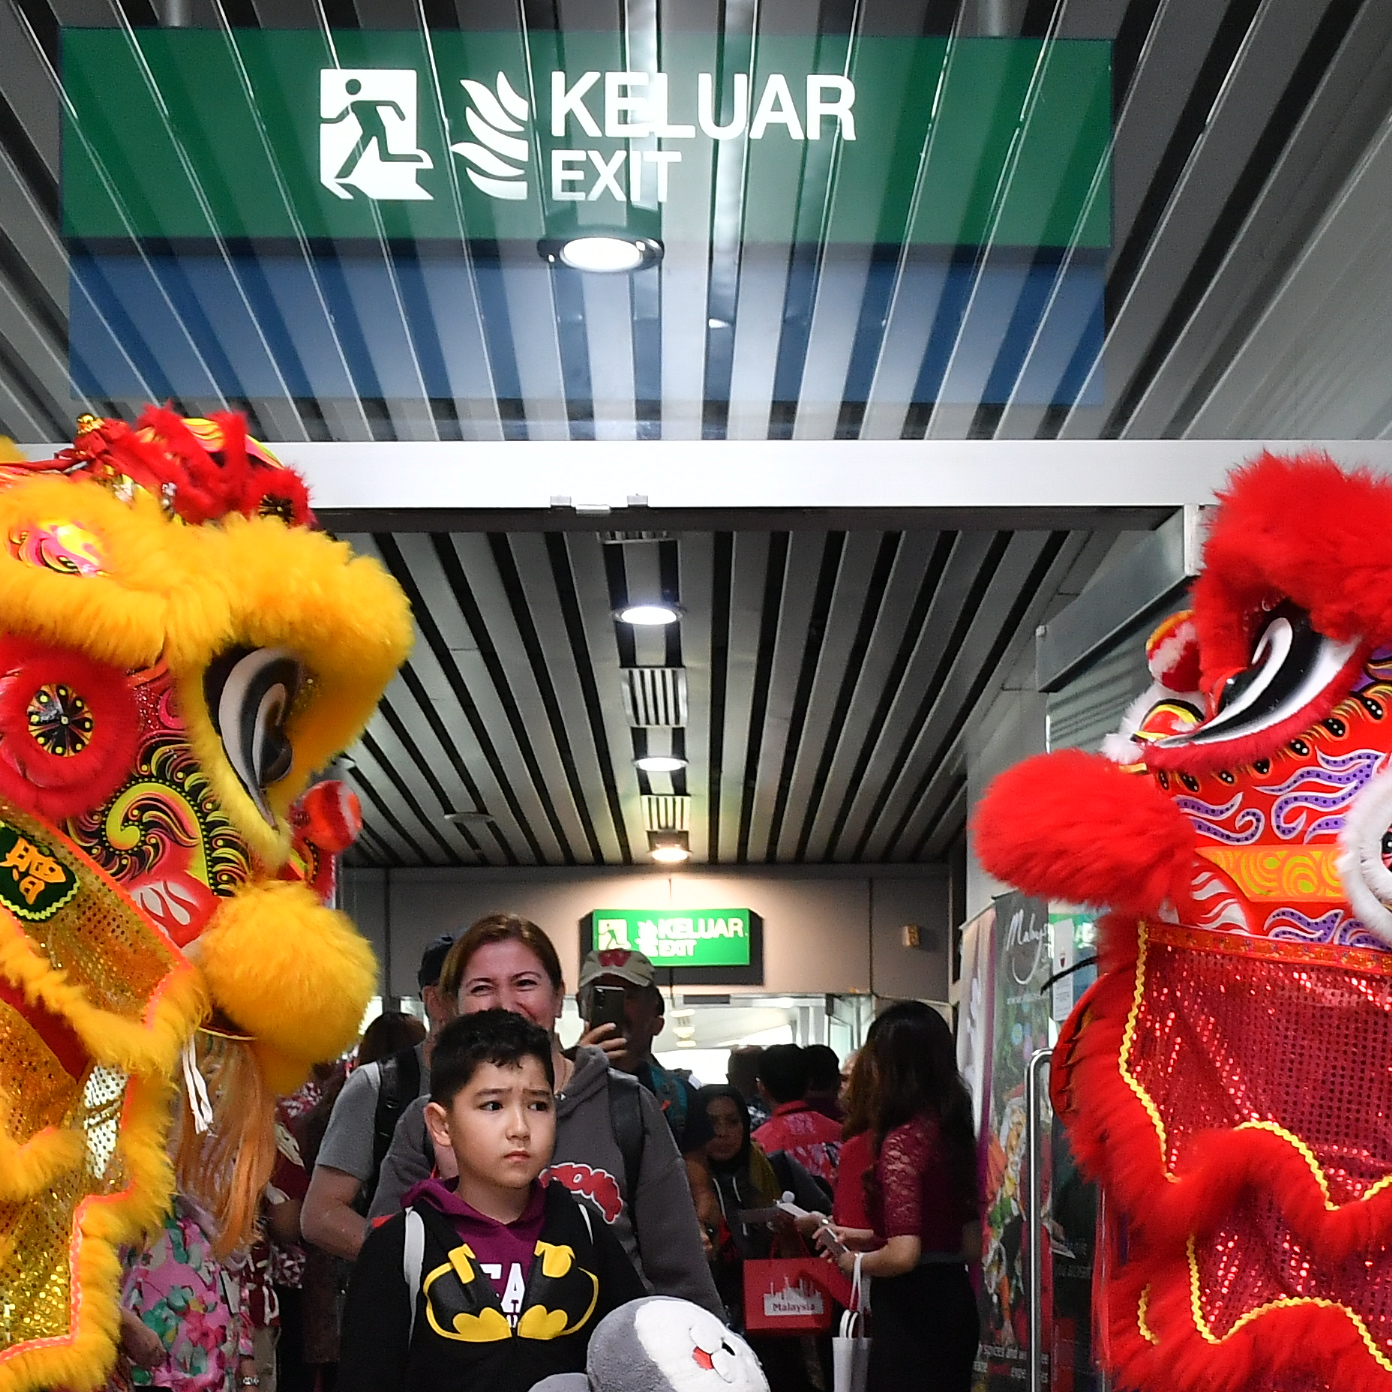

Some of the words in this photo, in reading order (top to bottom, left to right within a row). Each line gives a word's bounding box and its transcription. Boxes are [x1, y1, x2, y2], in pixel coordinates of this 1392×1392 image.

[551, 71, 857, 140] KELUAR
[551, 149, 682, 202] EXIT
[658, 917, 744, 939] KELUAR
[658, 939, 697, 957] EXIT
[773, 1303, 816, 1312] Malaysia
